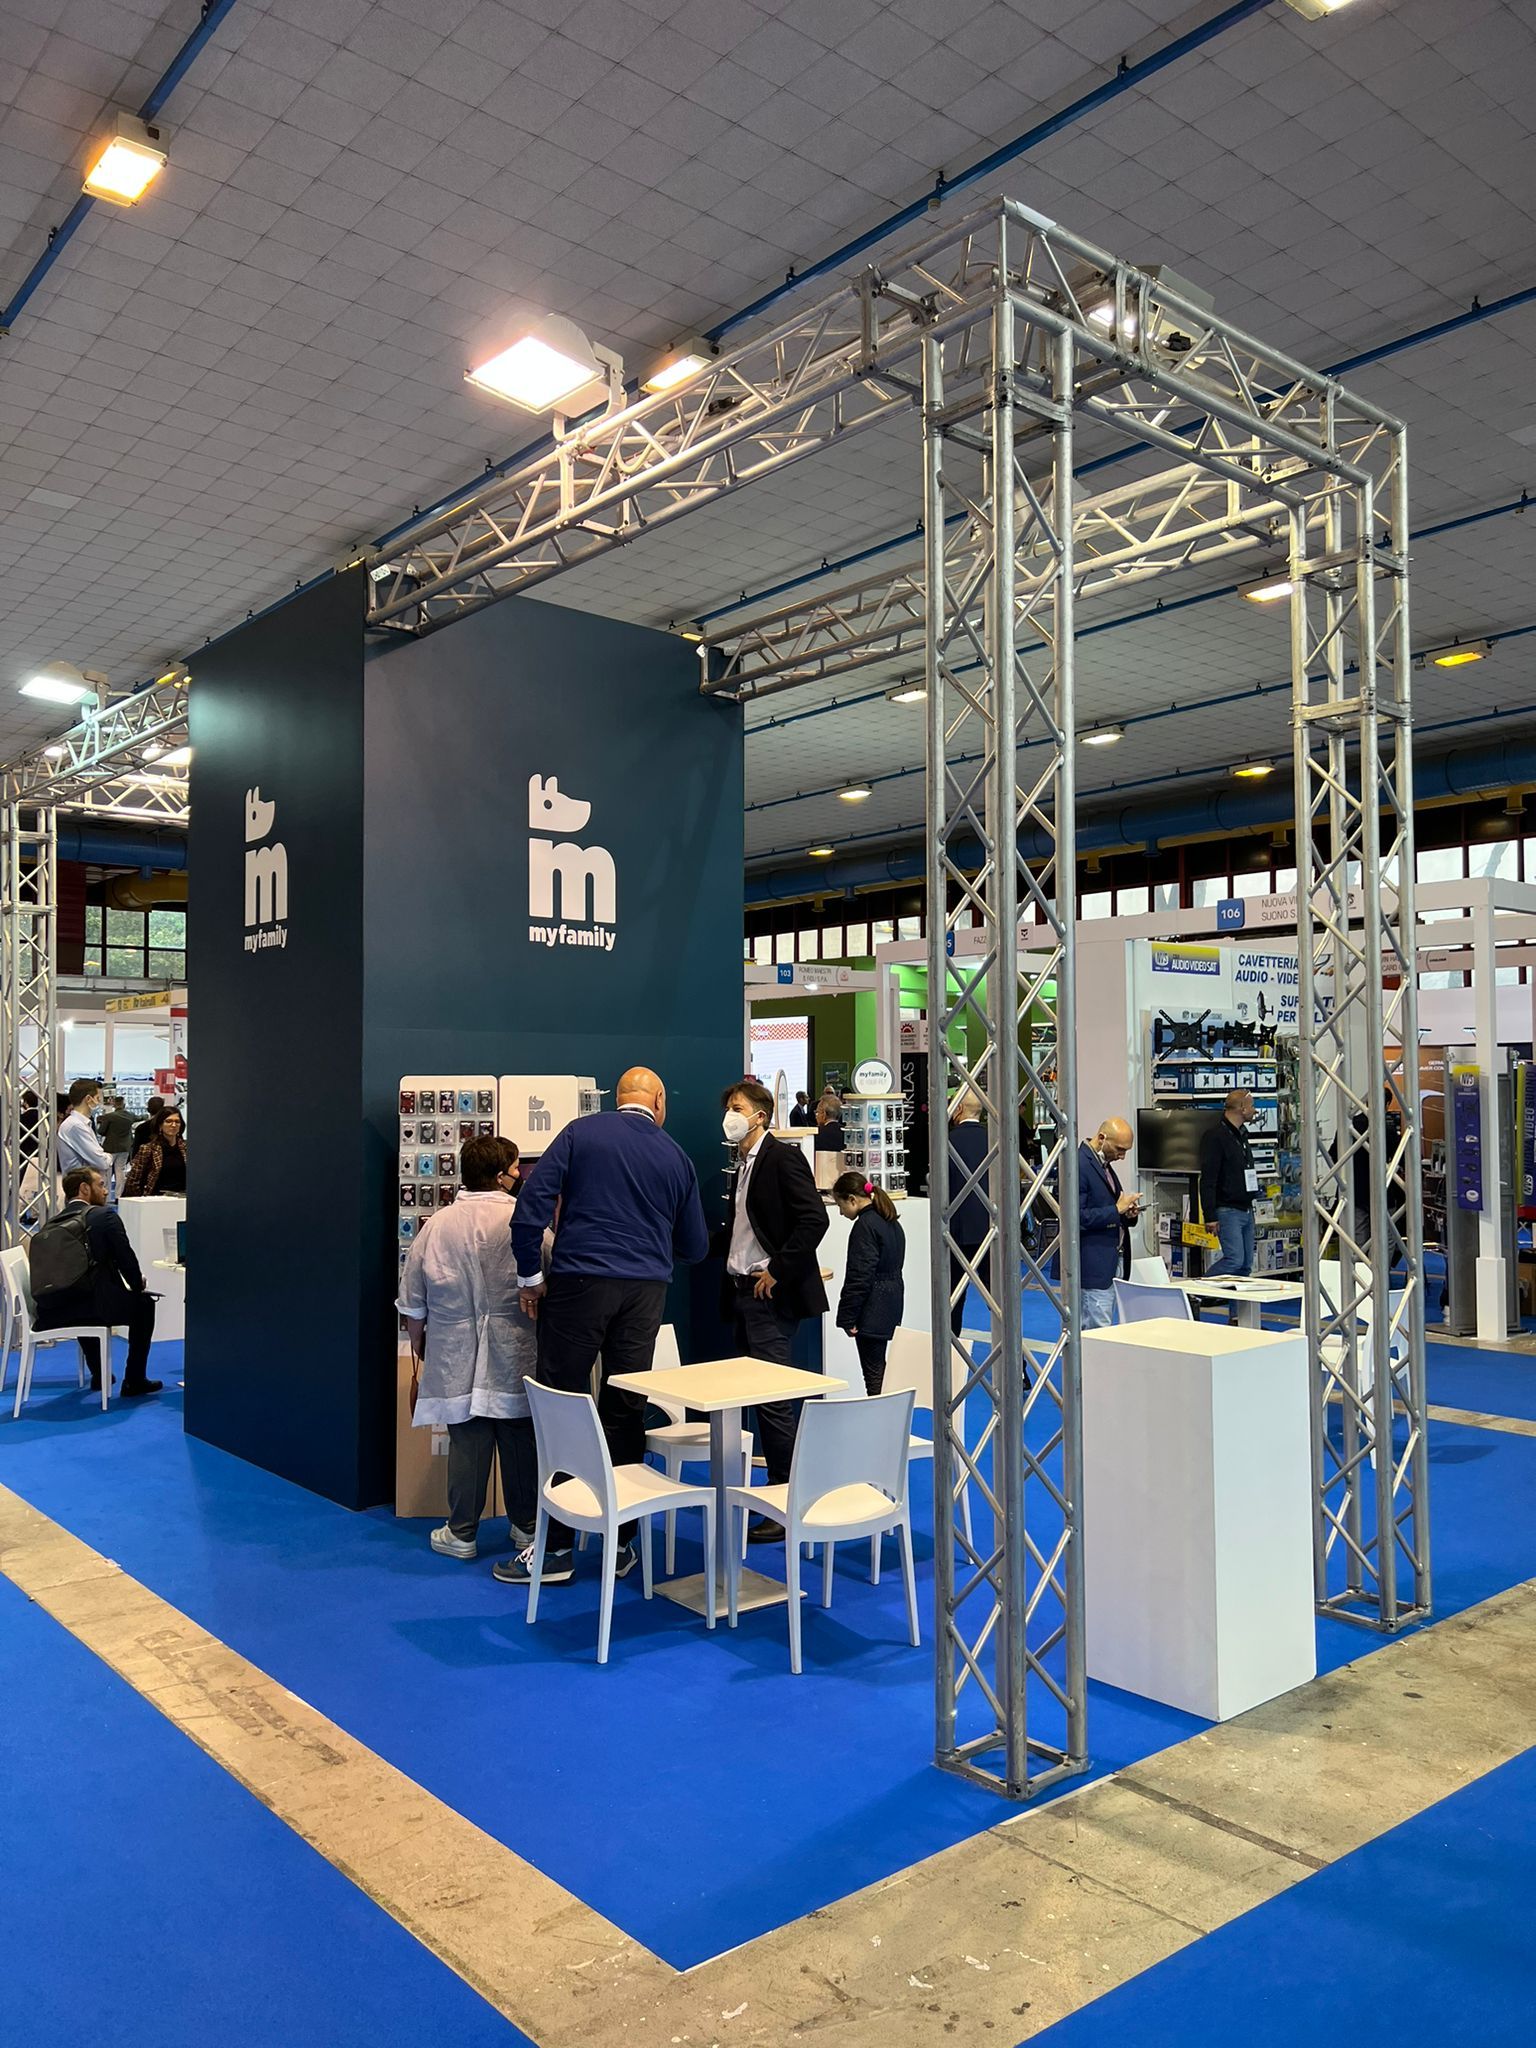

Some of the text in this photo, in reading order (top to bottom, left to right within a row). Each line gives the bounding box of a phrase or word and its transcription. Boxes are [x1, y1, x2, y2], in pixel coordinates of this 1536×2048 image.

[1261, 898, 1287, 908] NUOVA
[1221, 908, 1240, 920] 106
[1261, 911, 1288, 921] SUONO
[244, 923, 288, 953] myfamily
[529, 923, 616, 951] myfamily
[1238, 954, 1299, 969] CAVETTERIA
[780, 970, 791, 978] 103
[1235, 970, 1268, 983] AUDIO
[1277, 972, 1298, 985] VIDE
[1277, 1011, 1297, 1023] PER
[903, 1062, 915, 1125] NIKLAS
